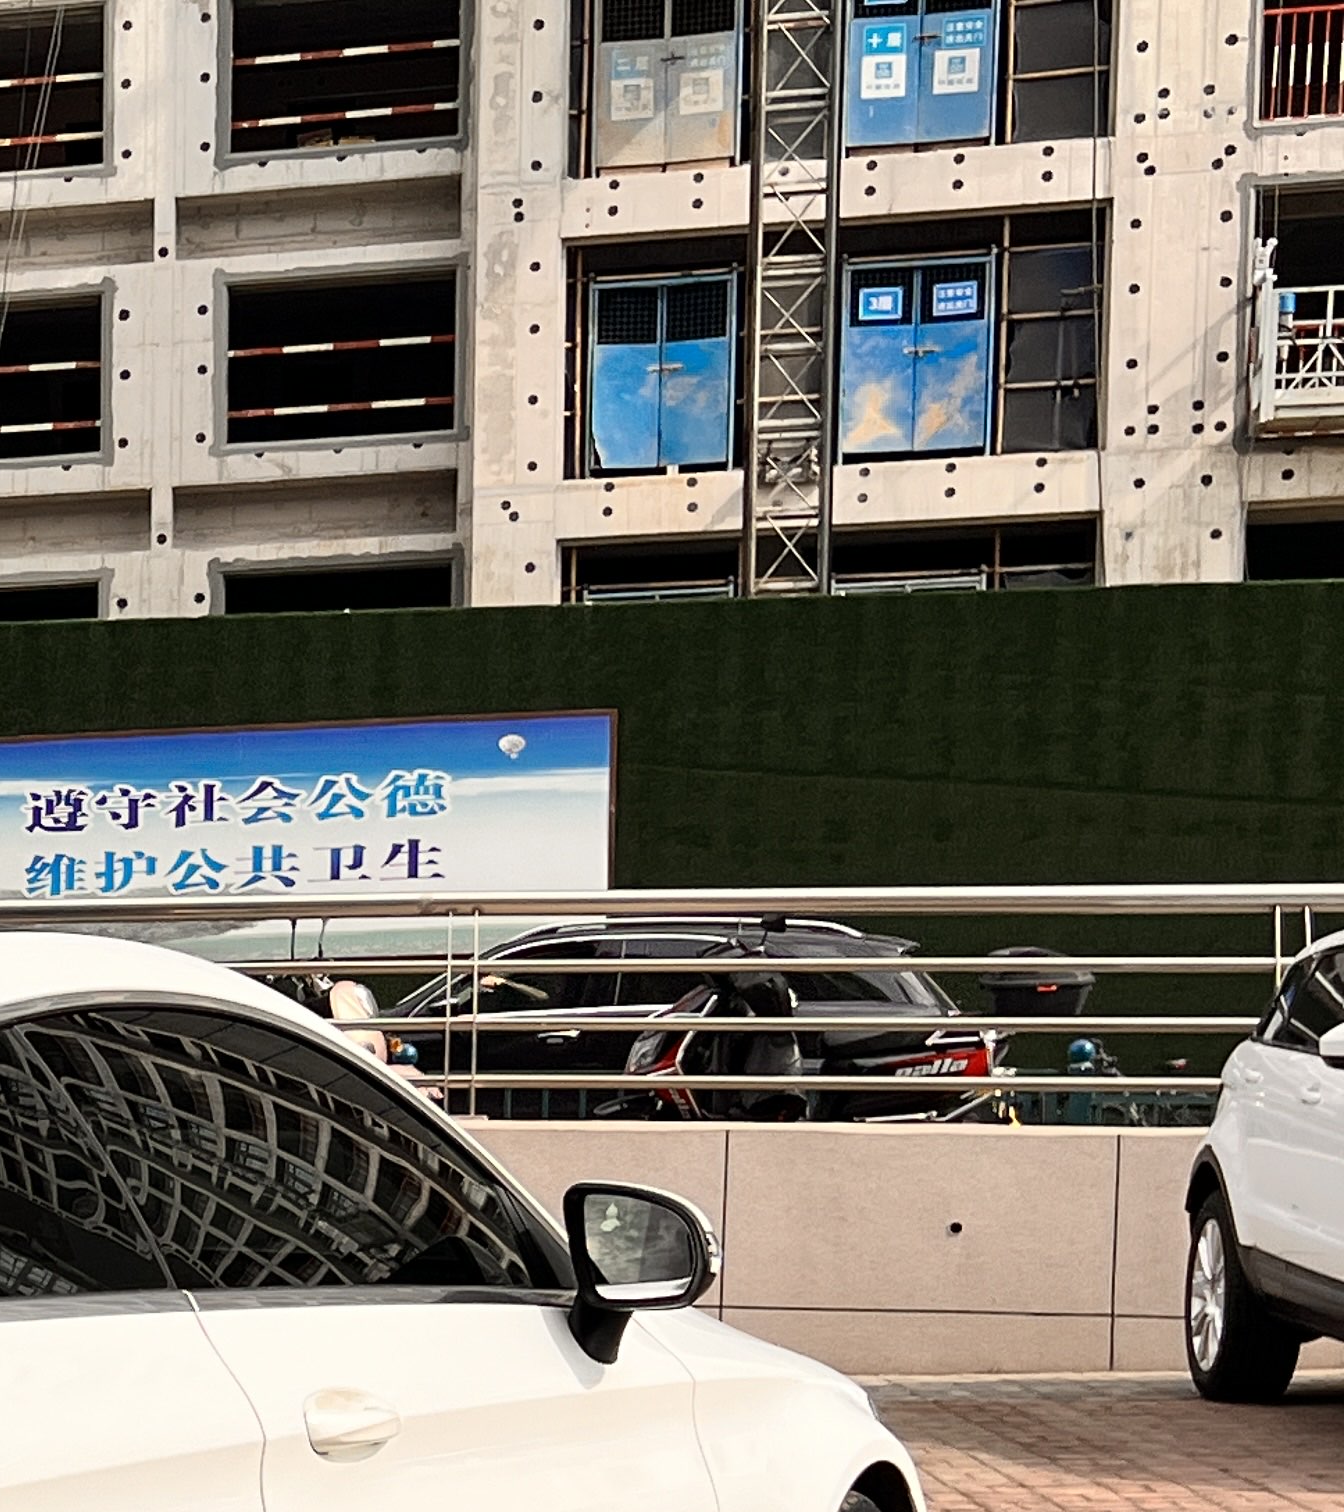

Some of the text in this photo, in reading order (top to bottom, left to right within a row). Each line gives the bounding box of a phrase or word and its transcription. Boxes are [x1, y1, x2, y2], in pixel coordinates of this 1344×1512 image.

[24, 770, 449, 832] 遵守社会公德
[24, 839, 447, 896] 维护公共卫生
